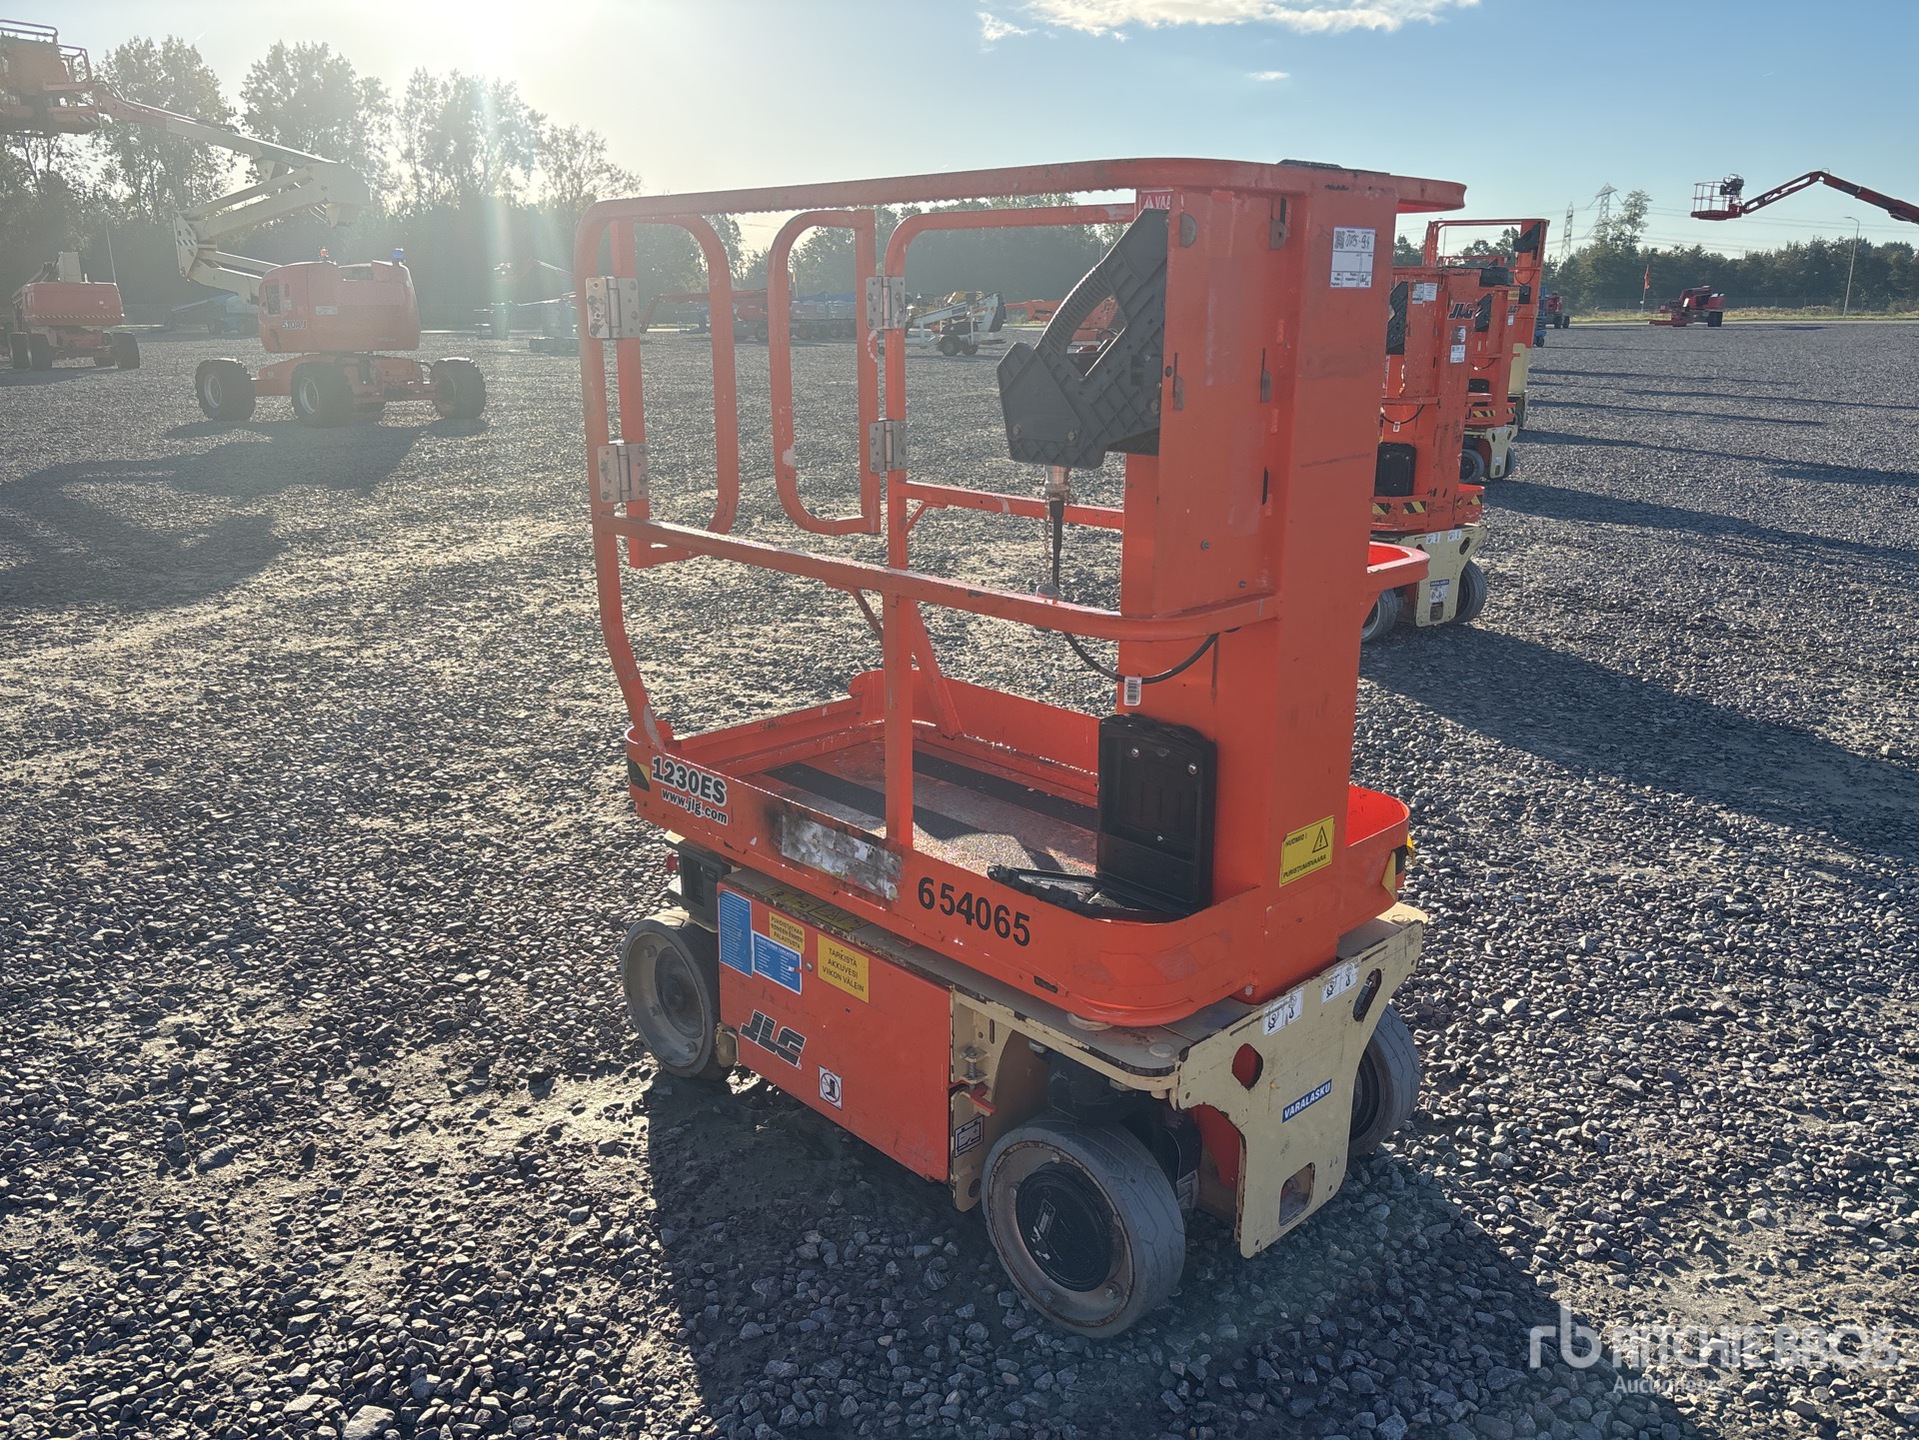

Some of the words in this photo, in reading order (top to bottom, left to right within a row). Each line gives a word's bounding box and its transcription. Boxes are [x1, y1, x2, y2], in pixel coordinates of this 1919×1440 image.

[1447, 302, 1476, 320] JLG
[652, 756, 727, 806] 1230ES
[661, 788, 728, 825] www.jlg.com
[917, 876, 1031, 947] 654065
[822, 965, 842, 981] VIIKON
[828, 959, 859, 978] AKKUVESI
[829, 948, 858, 967] TARKISTA
[739, 1009, 807, 1068] JLG
[1283, 1083, 1332, 1119] VARALASKU
